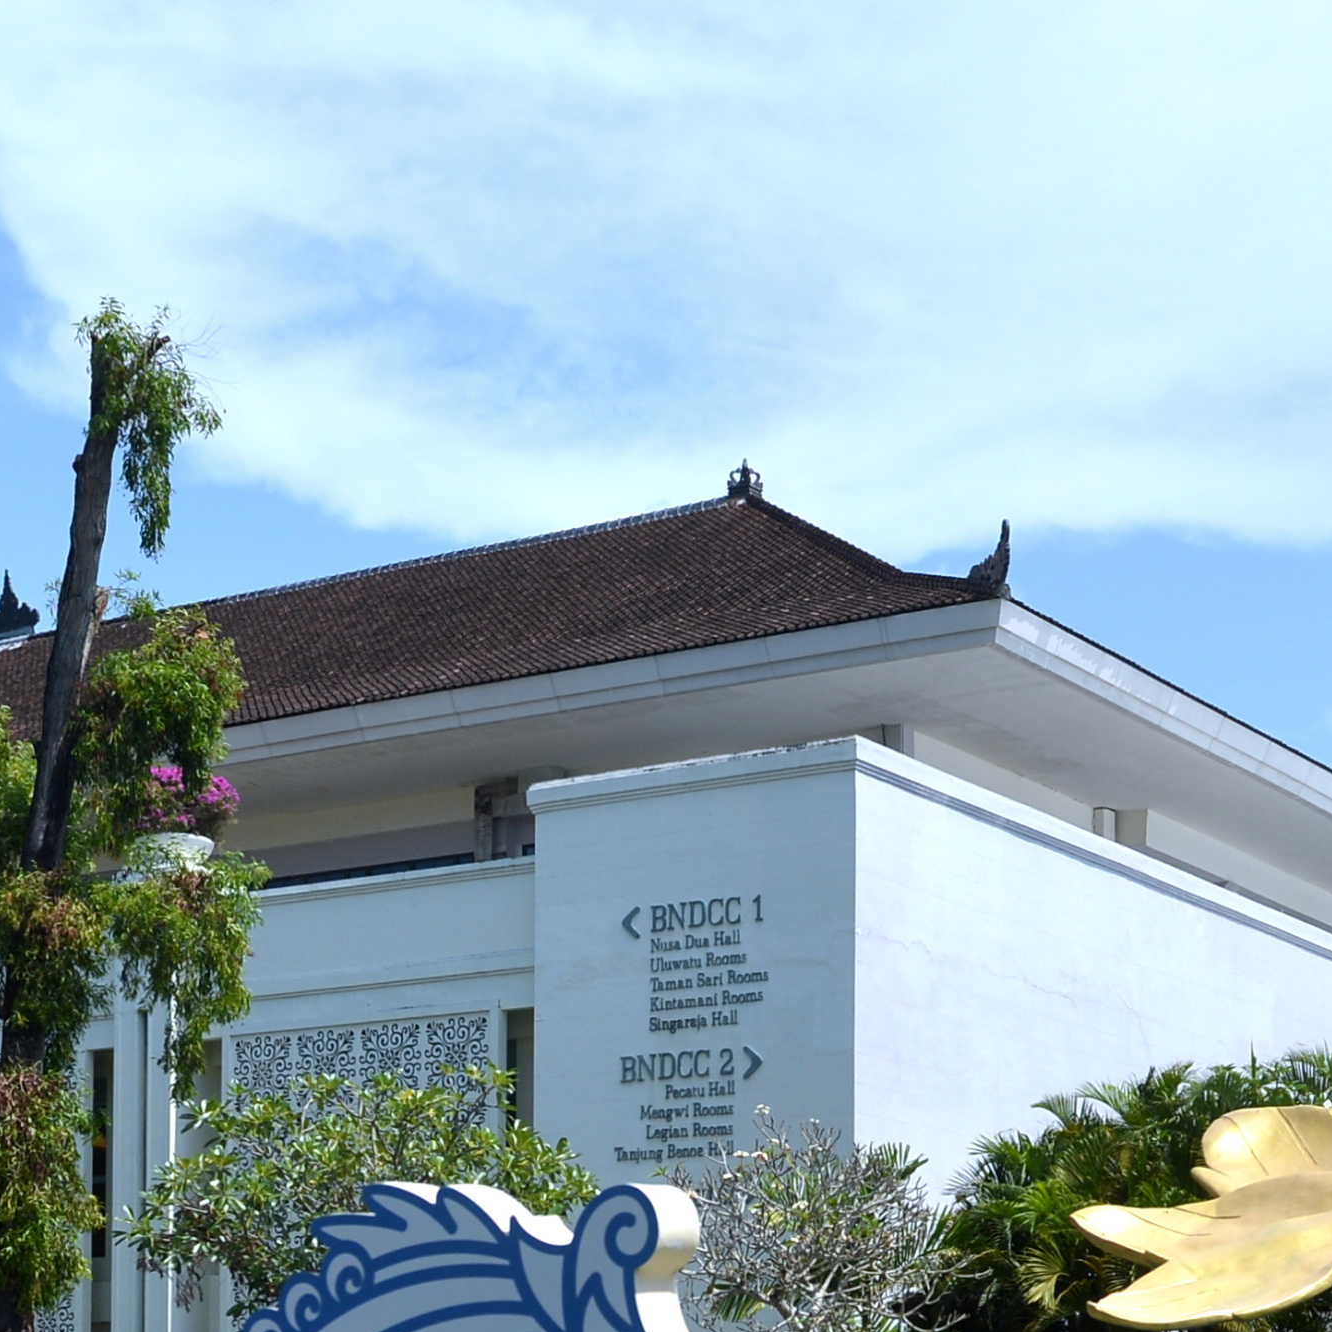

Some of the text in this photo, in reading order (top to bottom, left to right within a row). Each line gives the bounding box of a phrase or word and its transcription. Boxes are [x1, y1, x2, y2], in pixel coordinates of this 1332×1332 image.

[650, 894, 764, 933] BNDCC 1
[650, 929, 741, 953] Nusa Dua Hall
[650, 952, 748, 973] Uluwatu Rooms
[650, 969, 769, 993] Taman Sari Rooms
[650, 990, 764, 1013] Kintamani Rooms
[649, 1010, 738, 1034] Singaraja Hall
[620, 1048, 735, 1084] BNDCC 2
[665, 1080, 736, 1100] Pecatu Hall
[640, 1102, 734, 1122] Mengwi Rooms
[646, 1122, 734, 1142] Legian Rooms
[614, 1147, 664, 1164] Tanjung
[668, 1144, 704, 1159] Benoa
